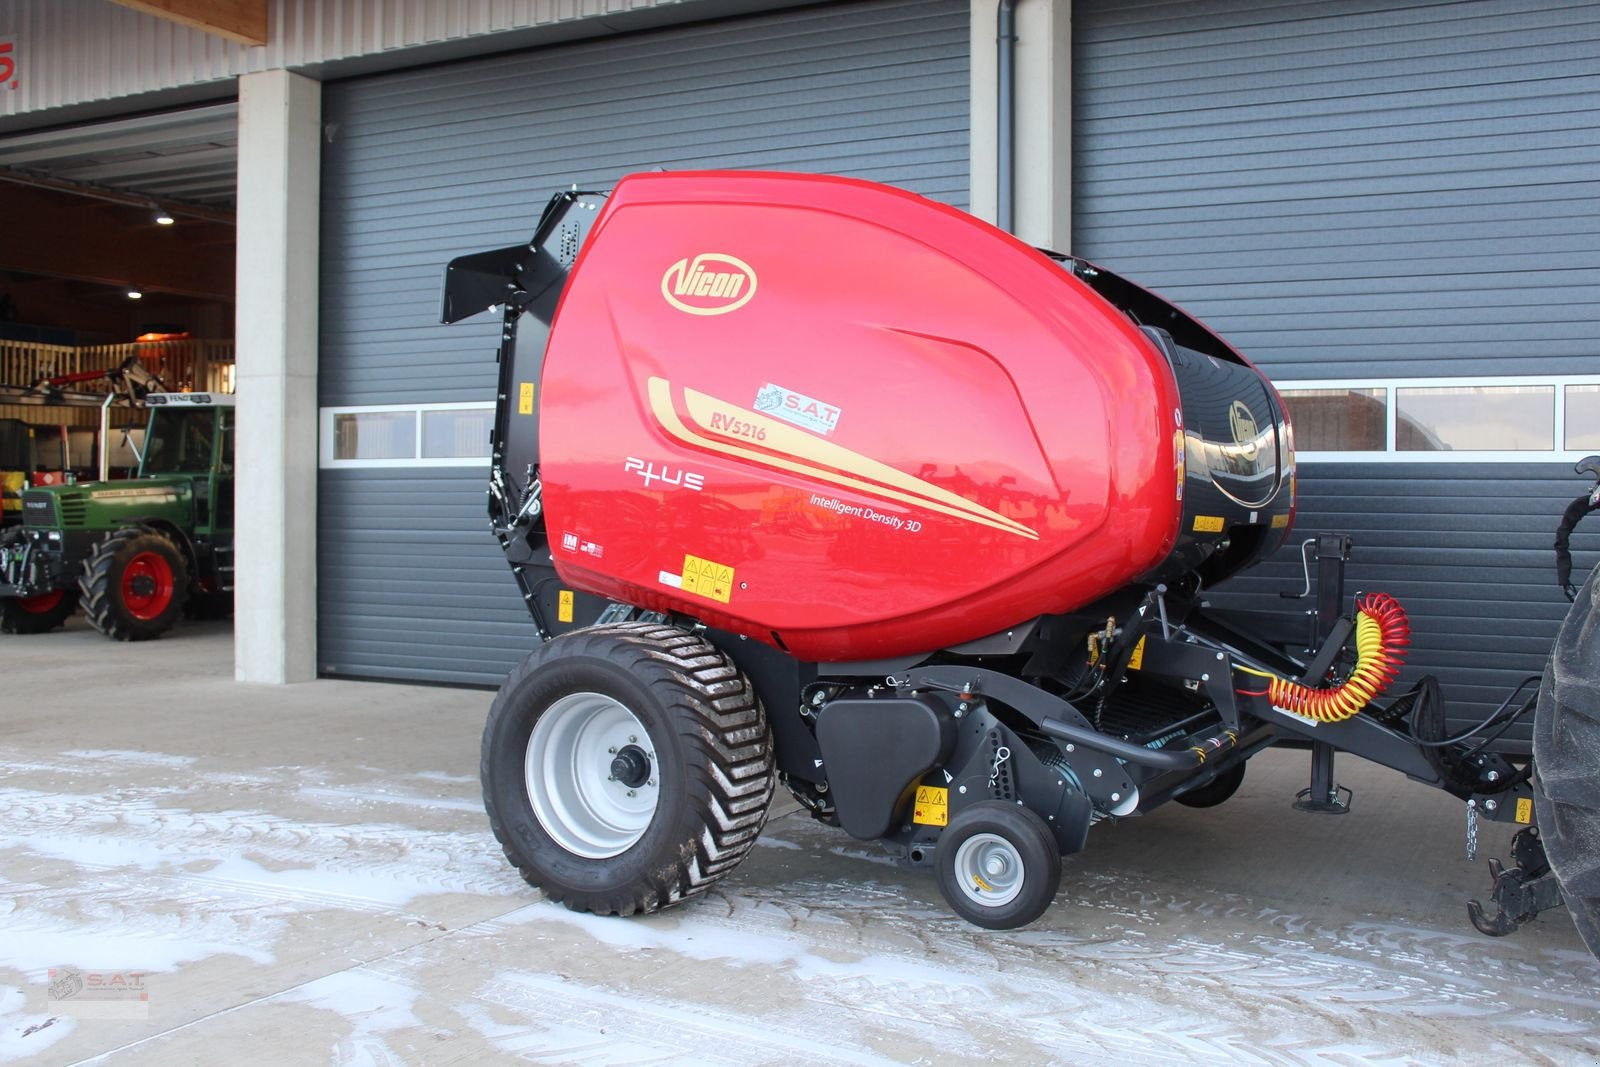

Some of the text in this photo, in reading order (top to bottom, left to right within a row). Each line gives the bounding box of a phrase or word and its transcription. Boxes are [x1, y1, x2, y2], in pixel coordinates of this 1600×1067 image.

[670, 255, 748, 301] Vicon
[710, 412, 766, 441] RV5216
[810, 494, 922, 532] Intelligent Density 3D
